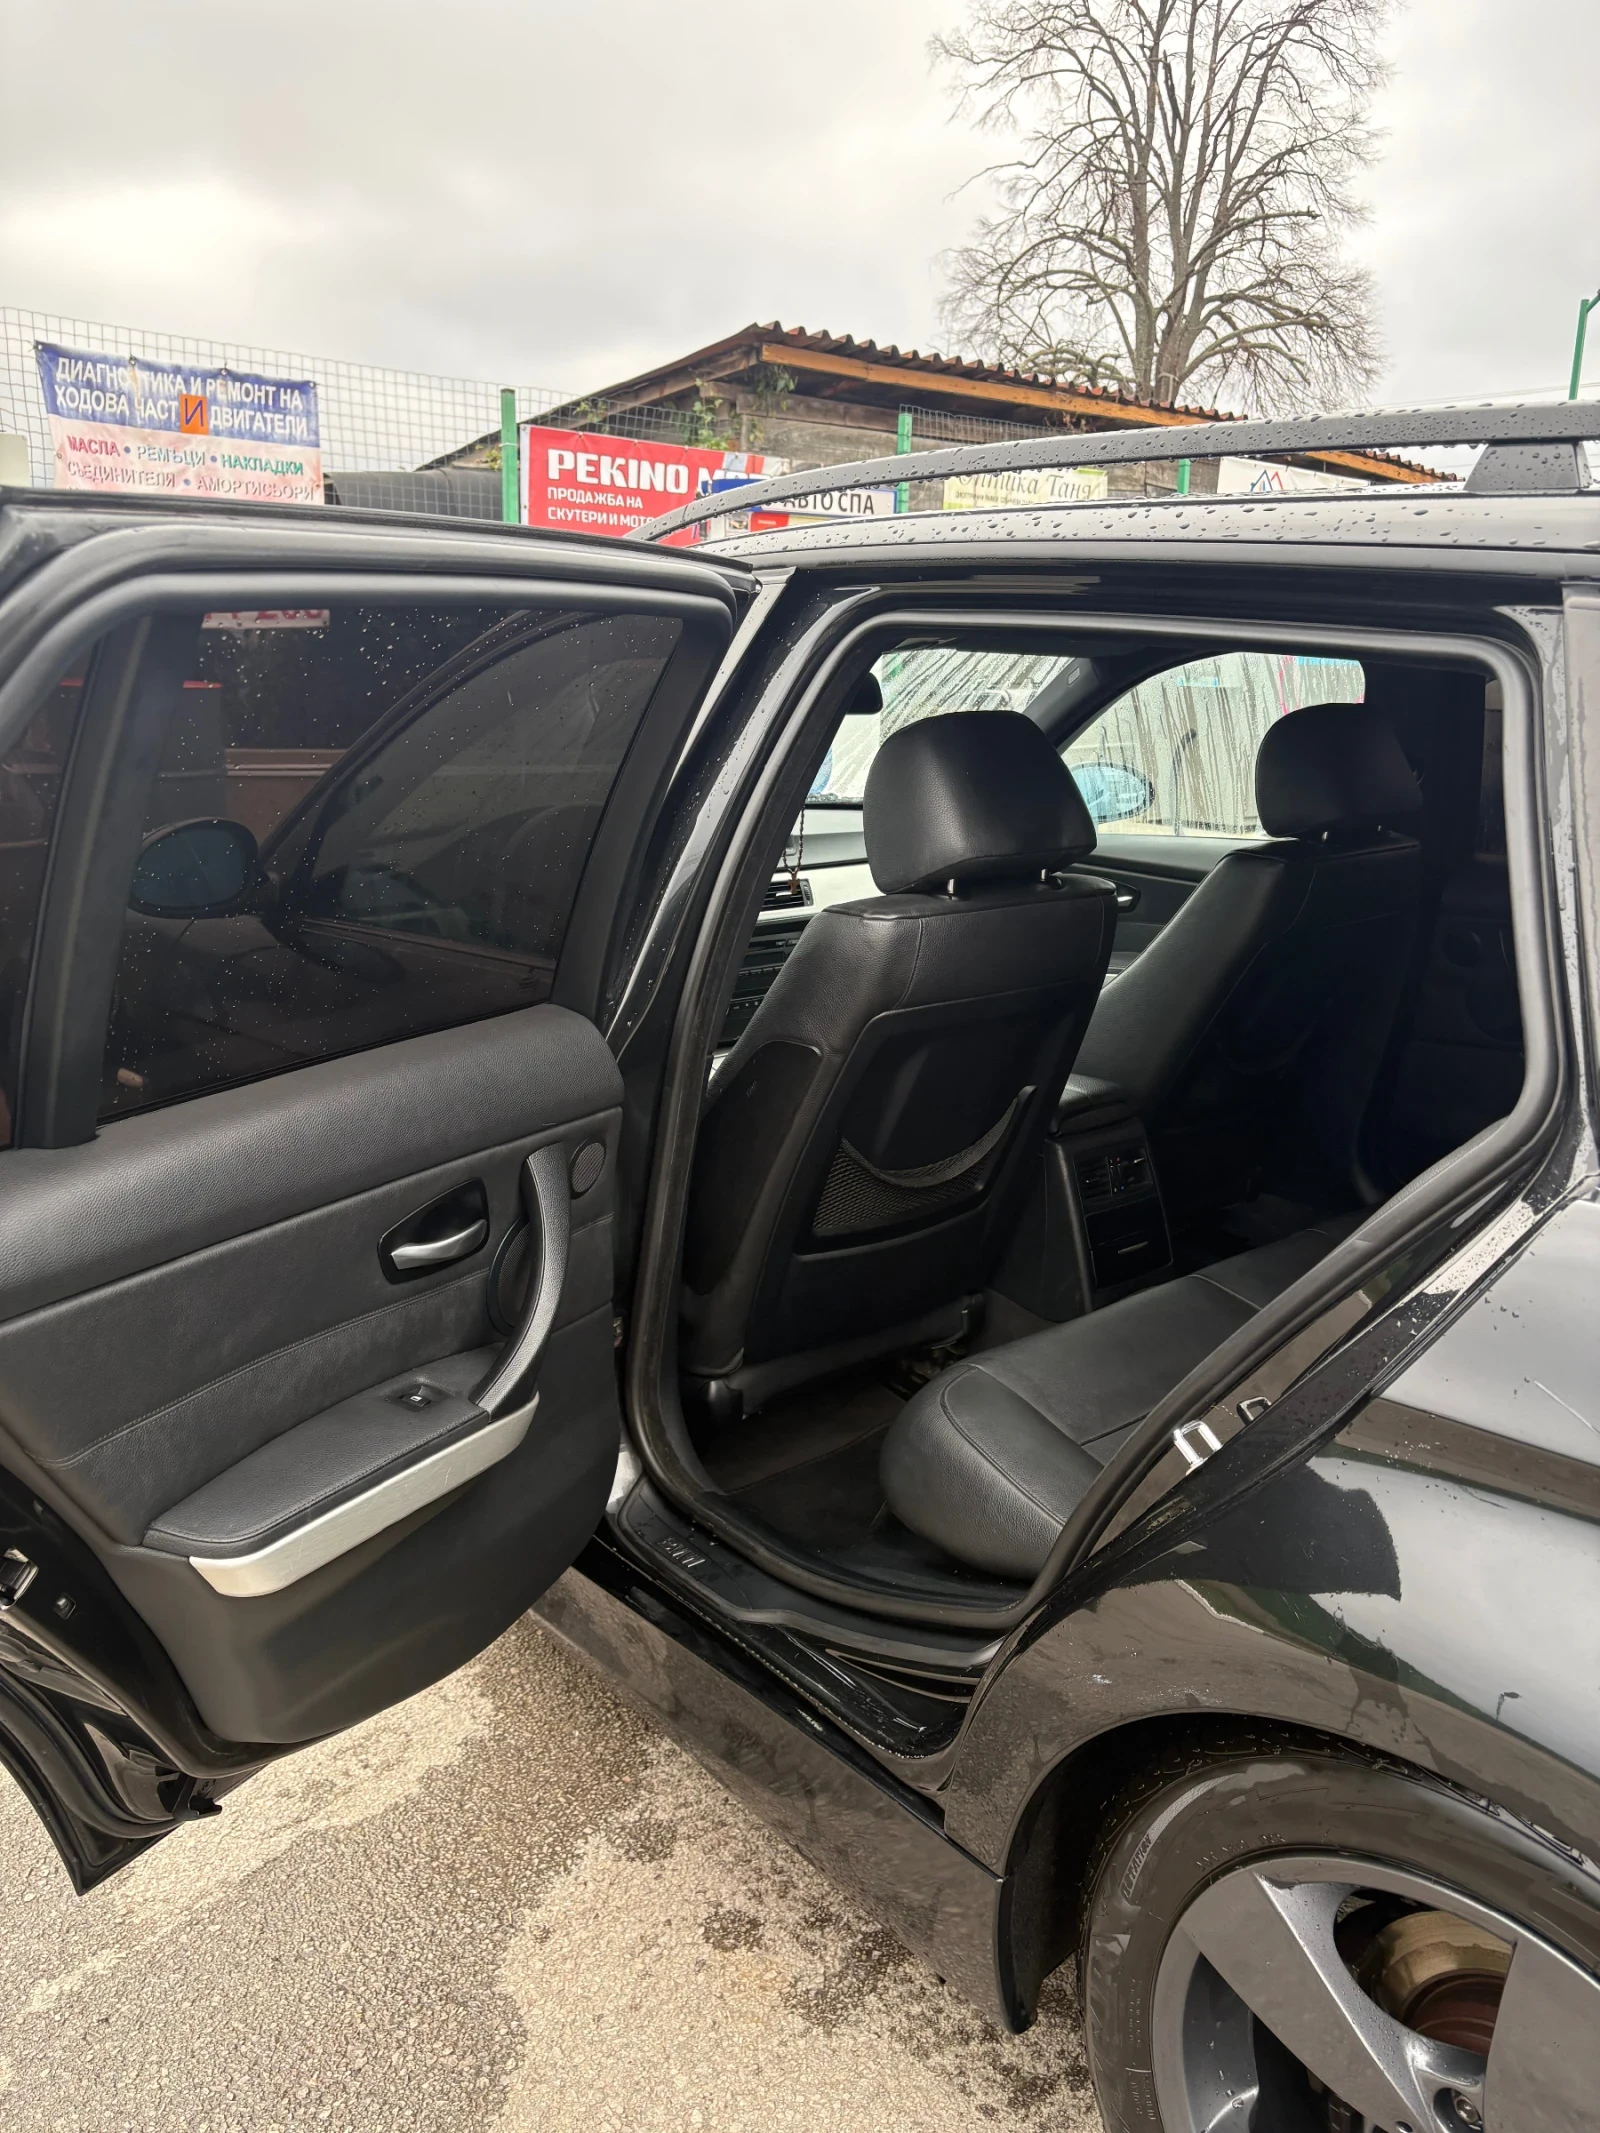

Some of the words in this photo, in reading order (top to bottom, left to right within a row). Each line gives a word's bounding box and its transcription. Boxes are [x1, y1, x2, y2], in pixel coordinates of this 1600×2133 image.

[56, 357, 187, 394] ДИАГНОТИКА
[190, 376, 202, 396] И
[206, 378, 276, 406] РЕМОНТ
[280, 388, 303, 411] НА
[54, 384, 130, 417] ХОДОВА
[134, 397, 179, 422] ЧАСТ
[184, 398, 204, 428] И
[210, 405, 308, 438] ДВИГАТЕЛИ
[66, 435, 121, 457] МАСЛА
[137, 446, 206, 468] РЕМЪЦИ
[222, 454, 304, 476] НАКЛАДКИ
[547, 448, 689, 494] PEKINO
[197, 476, 315, 501] АМОРТИСЬОРИ
[547, 486, 625, 507] ПРОДАЖБА
[626, 495, 643, 509] НА
[1046, 474, 1095, 500] Таня
[547, 506, 607, 525] СКУТЕРИ
[609, 513, 618, 526] И
[838, 493, 875, 515] СПА
